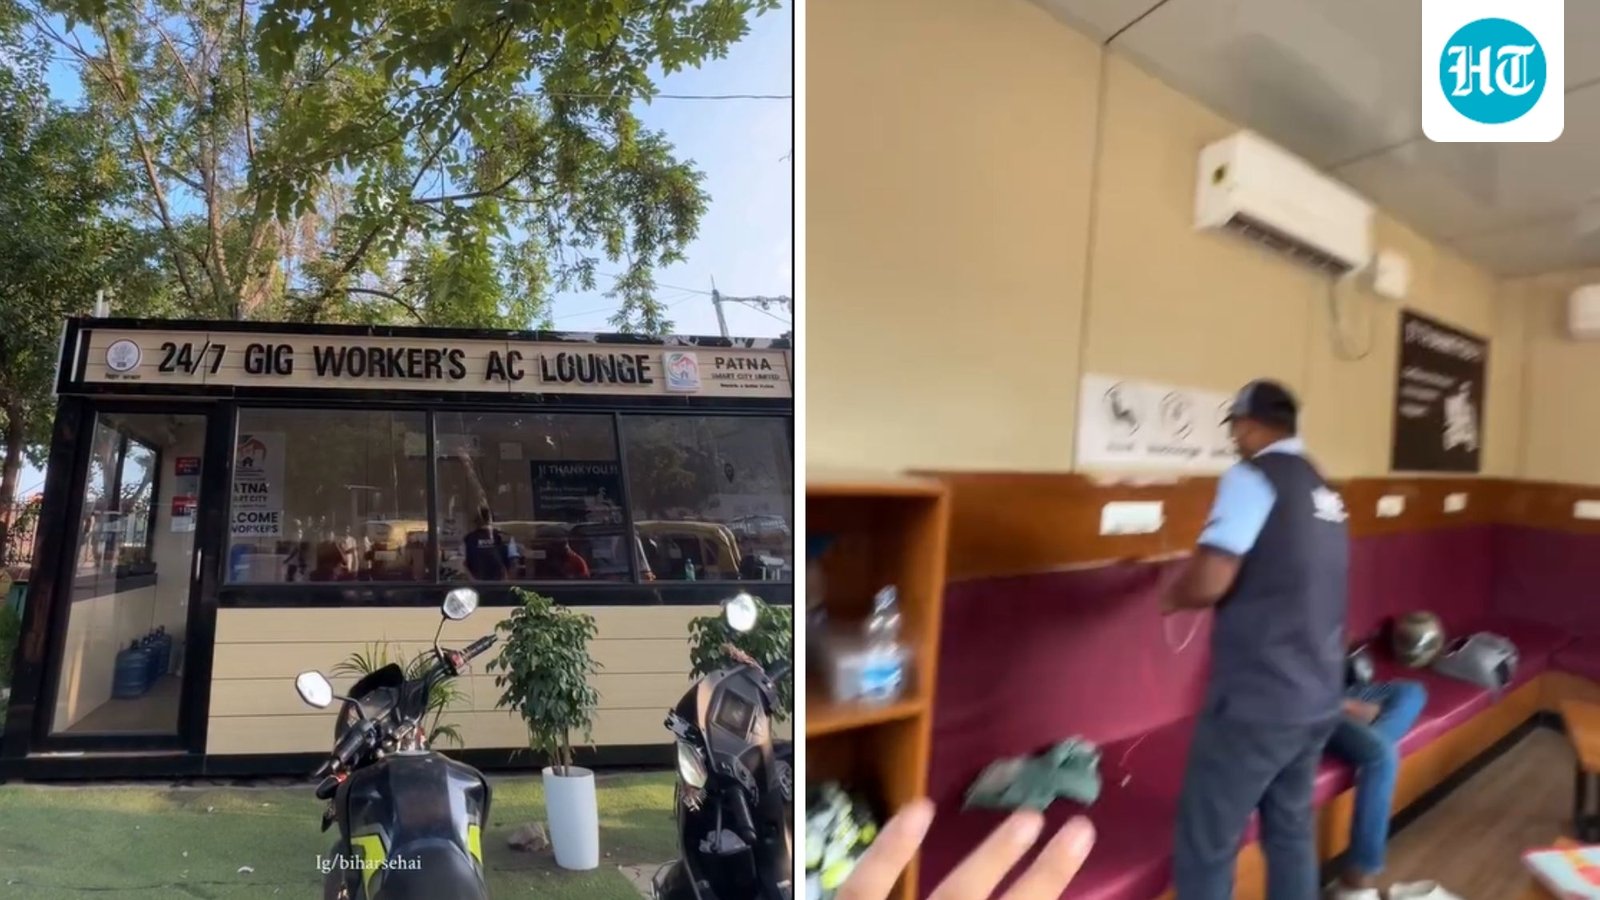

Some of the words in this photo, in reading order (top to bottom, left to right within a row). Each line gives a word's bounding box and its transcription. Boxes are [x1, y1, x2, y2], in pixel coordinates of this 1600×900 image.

[158, 341, 228, 375] 24/7
[244, 344, 294, 376] GIG
[313, 346, 466, 381] WORKER'S
[485, 350, 524, 382] AC
[540, 351, 654, 385] LOUNGE
[714, 356, 772, 371] PATNA
[711, 372, 735, 380] SMART
[233, 482, 268, 493] ATNA
